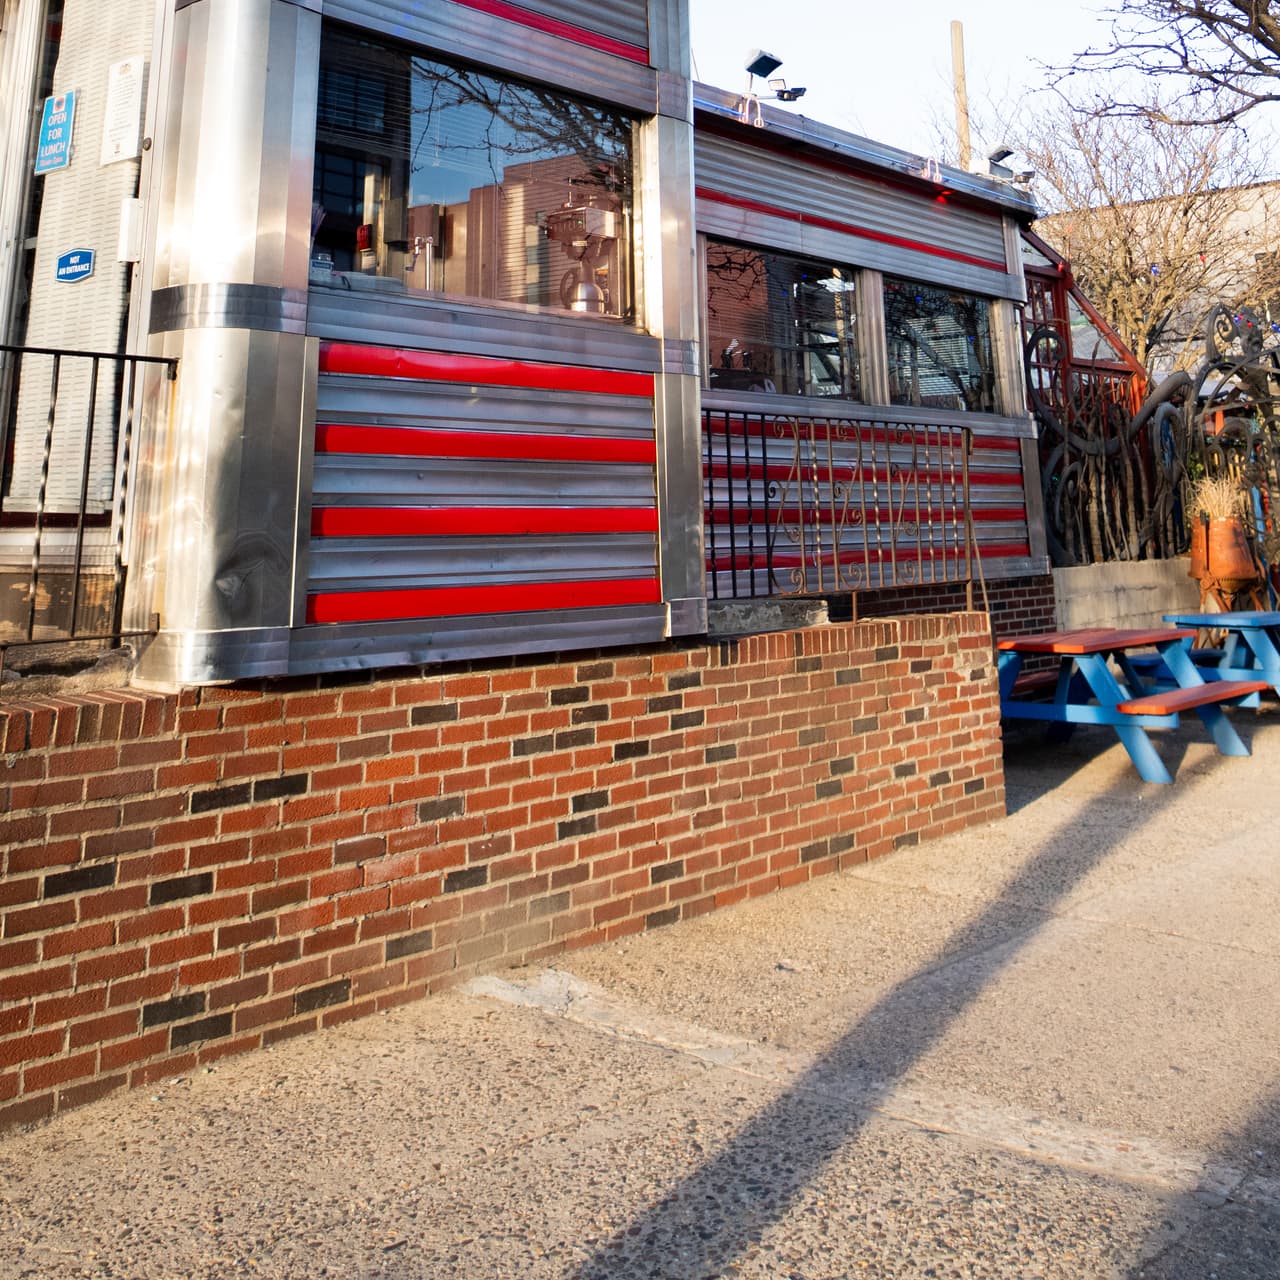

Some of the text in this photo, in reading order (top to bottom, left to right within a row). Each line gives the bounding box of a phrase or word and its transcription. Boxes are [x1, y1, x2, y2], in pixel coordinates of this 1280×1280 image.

[48, 112, 67, 126] OPEN
[48, 128, 63, 141] FOR
[41, 141, 66, 157] LUNCH
[69, 255, 81, 265] NOT
[58, 263, 90, 276] AN ENTRANCE
